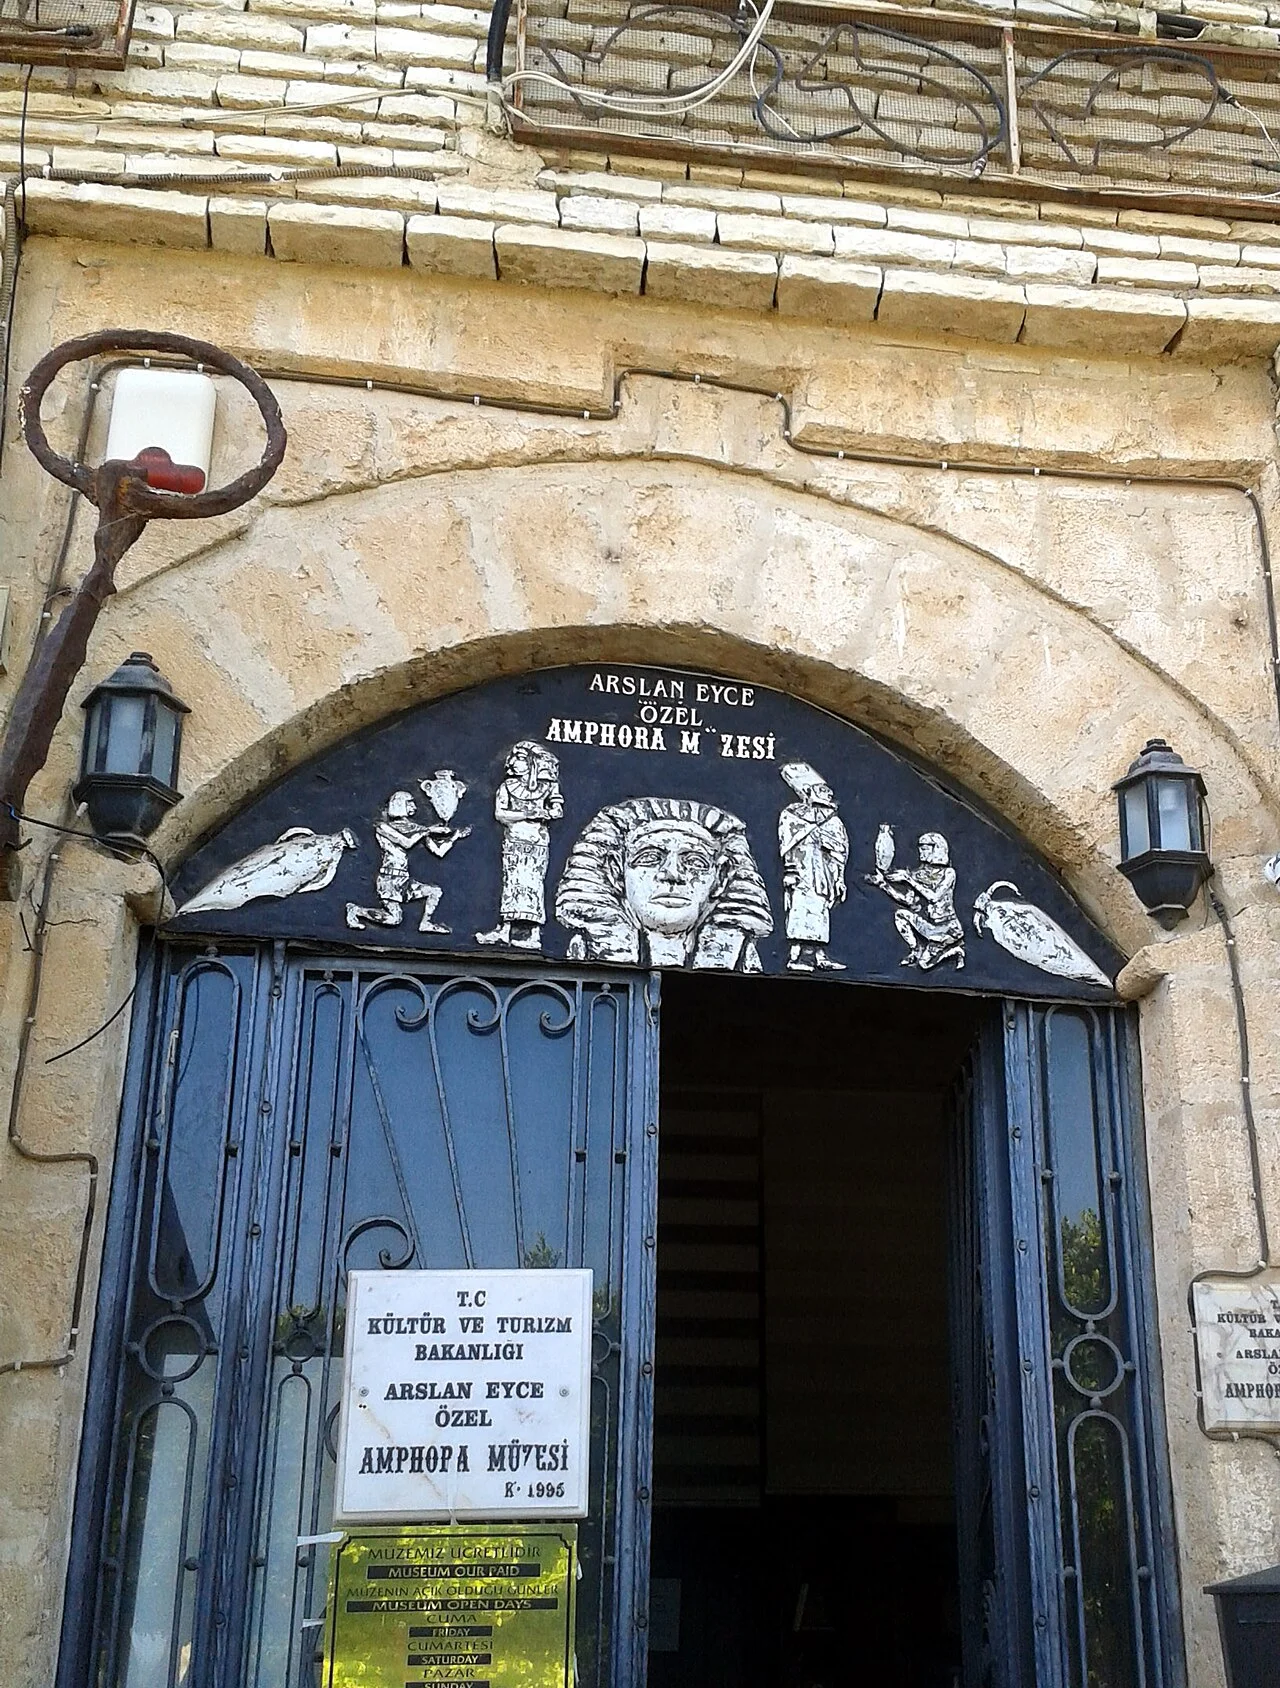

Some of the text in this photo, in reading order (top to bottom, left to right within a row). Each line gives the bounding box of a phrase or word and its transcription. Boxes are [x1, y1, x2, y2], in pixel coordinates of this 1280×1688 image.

[589, 673, 755, 707] ARSLAN EYCE
[546, 717, 667, 752] AMPHORA
[367, 1312, 446, 1335] KÜLTÜR
[458, 1316, 484, 1334] VE
[384, 1381, 544, 1400] ARSLAN EYCE
[435, 1404, 492, 1427] ÖZEL
[388, 1565, 520, 1578] MUSEUM OUR PAID
[372, 1599, 532, 1611] MUSEUM OPEN DAYS
[427, 1614, 477, 1624] CUMA
[432, 1627, 471, 1637] FRIDAY
[421, 1655, 479, 1665] SATURDAY
[424, 1668, 475, 1679] PAZAR
